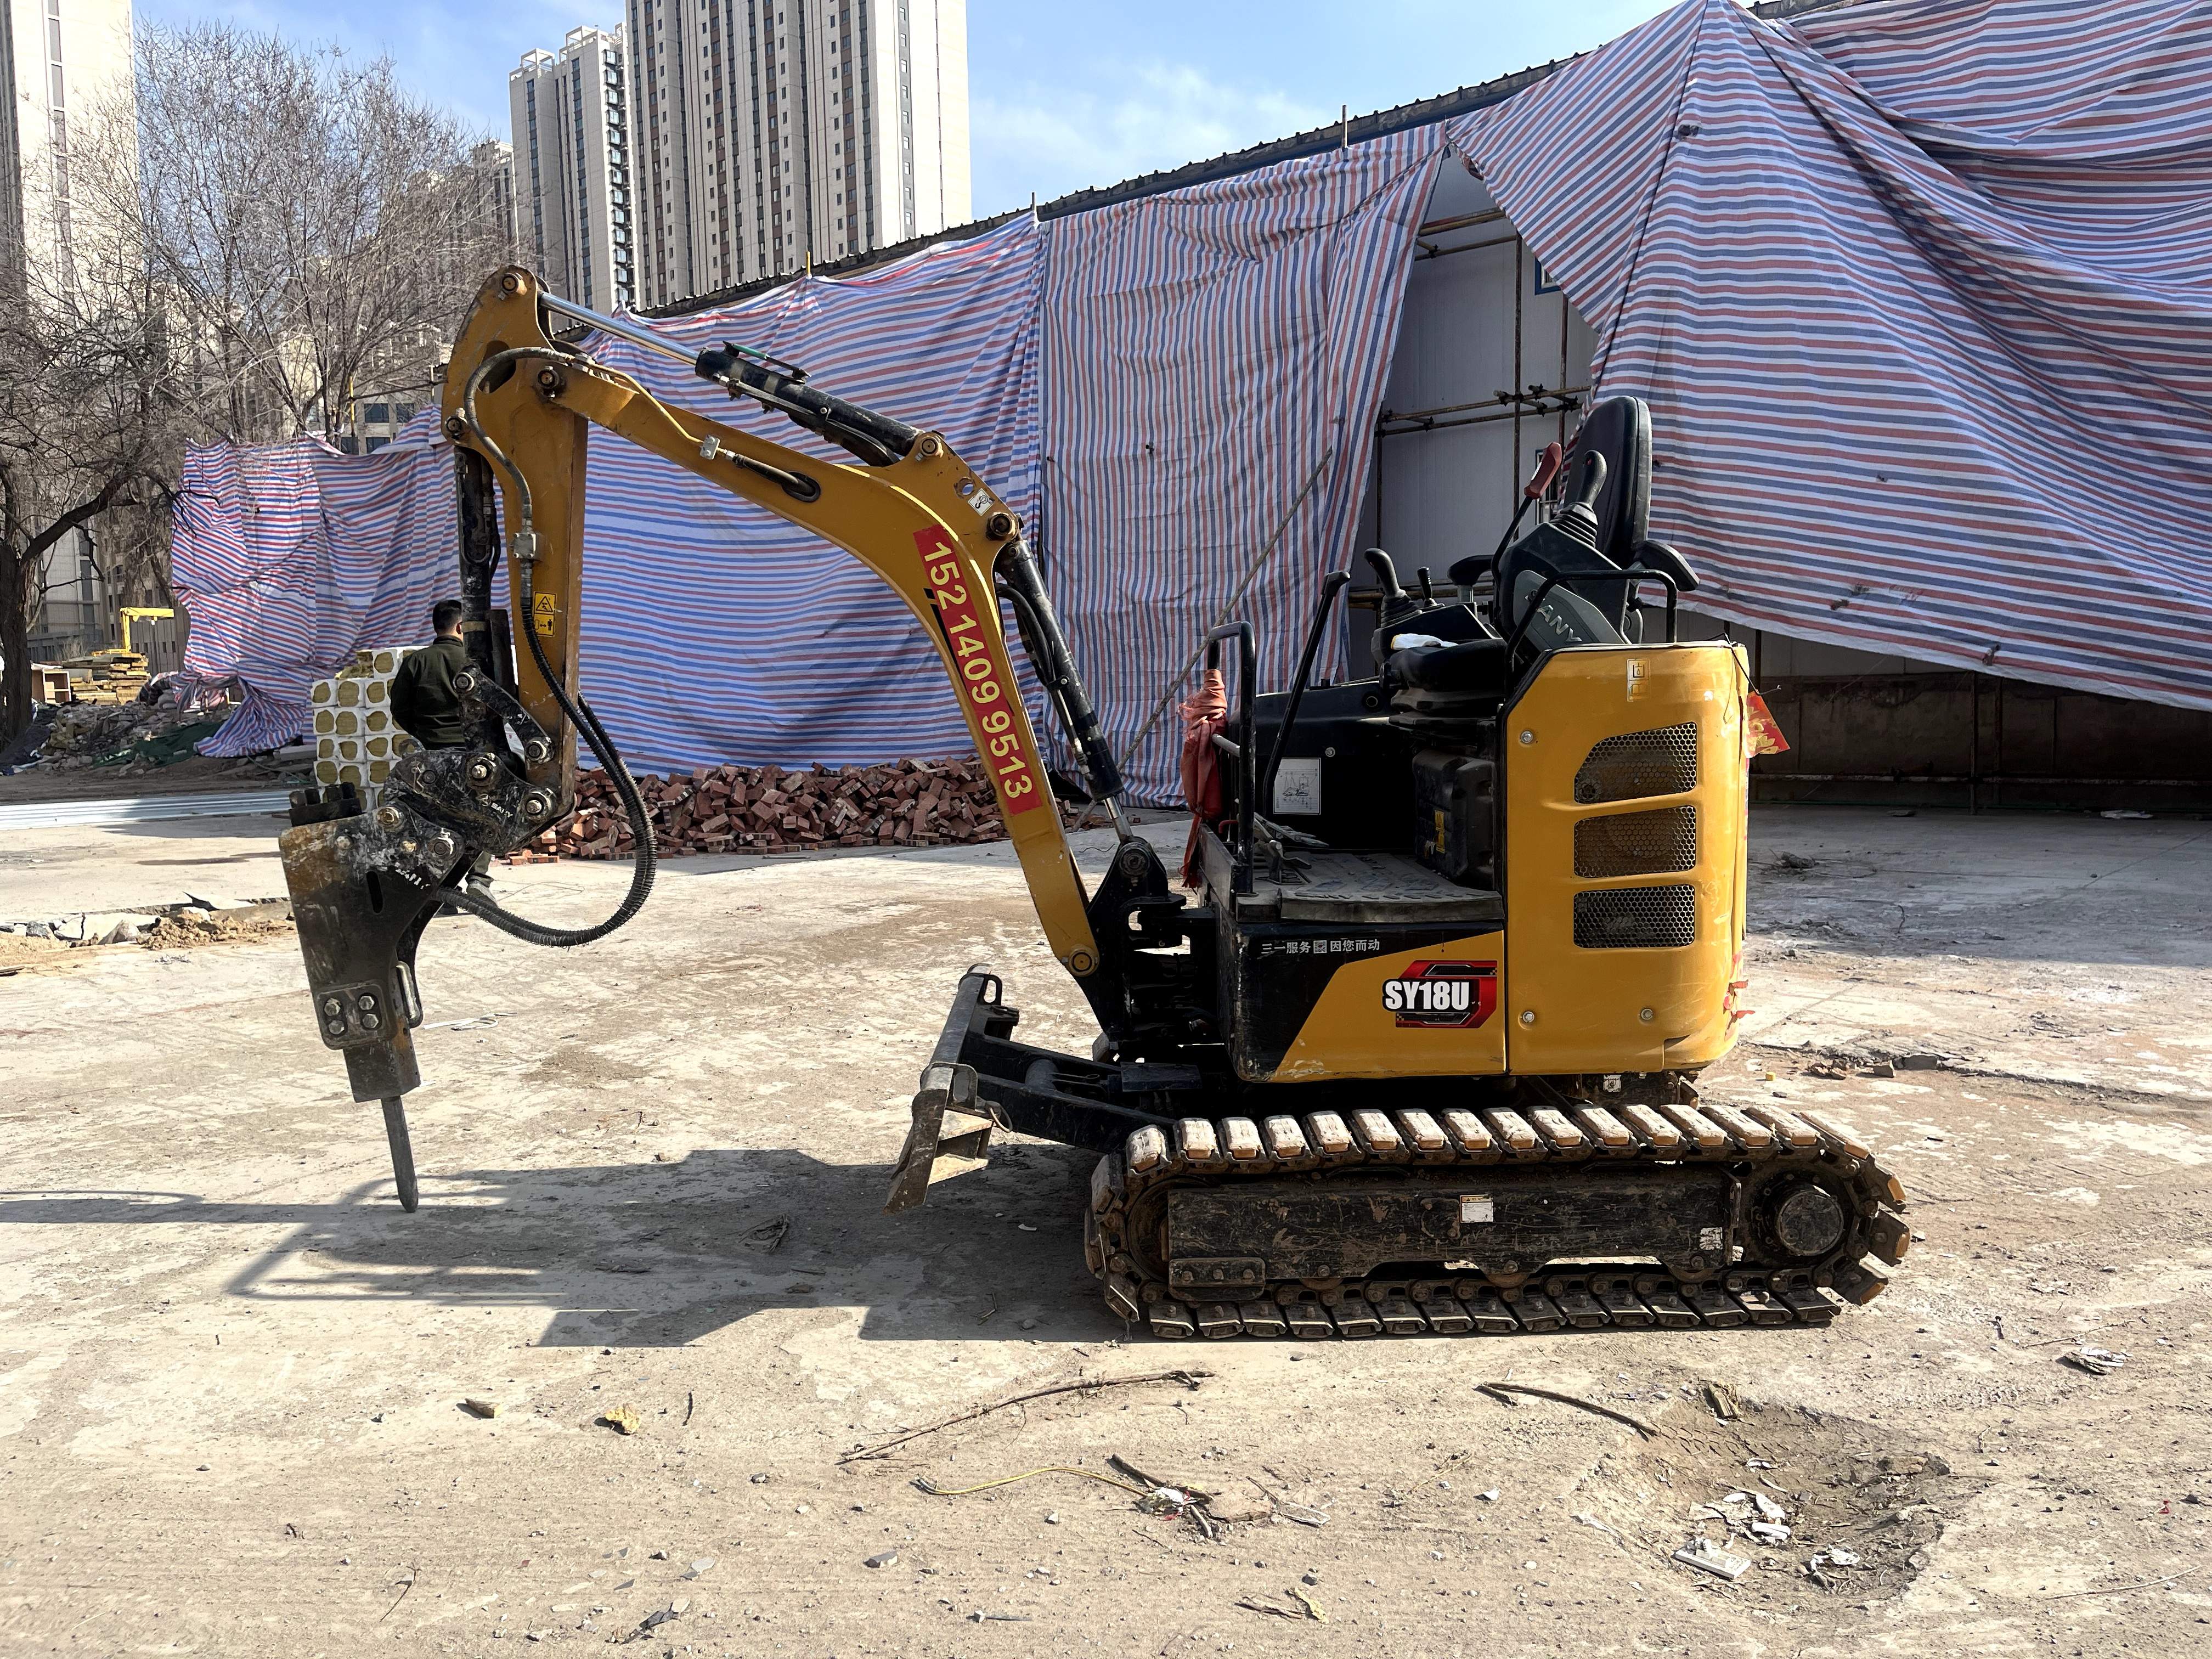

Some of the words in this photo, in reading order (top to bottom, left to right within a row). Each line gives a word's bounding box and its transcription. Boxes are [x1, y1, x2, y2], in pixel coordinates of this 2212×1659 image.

[1536, 598, 1582, 641] ANY
[924, 541, 967, 610] 152
[950, 614, 1000, 703] 1409
[982, 710, 1032, 799] 9513
[1261, 940, 1311, 954] 三一服务
[1330, 939, 1380, 952] 因您而动
[1385, 981, 1470, 1011] SY18U
